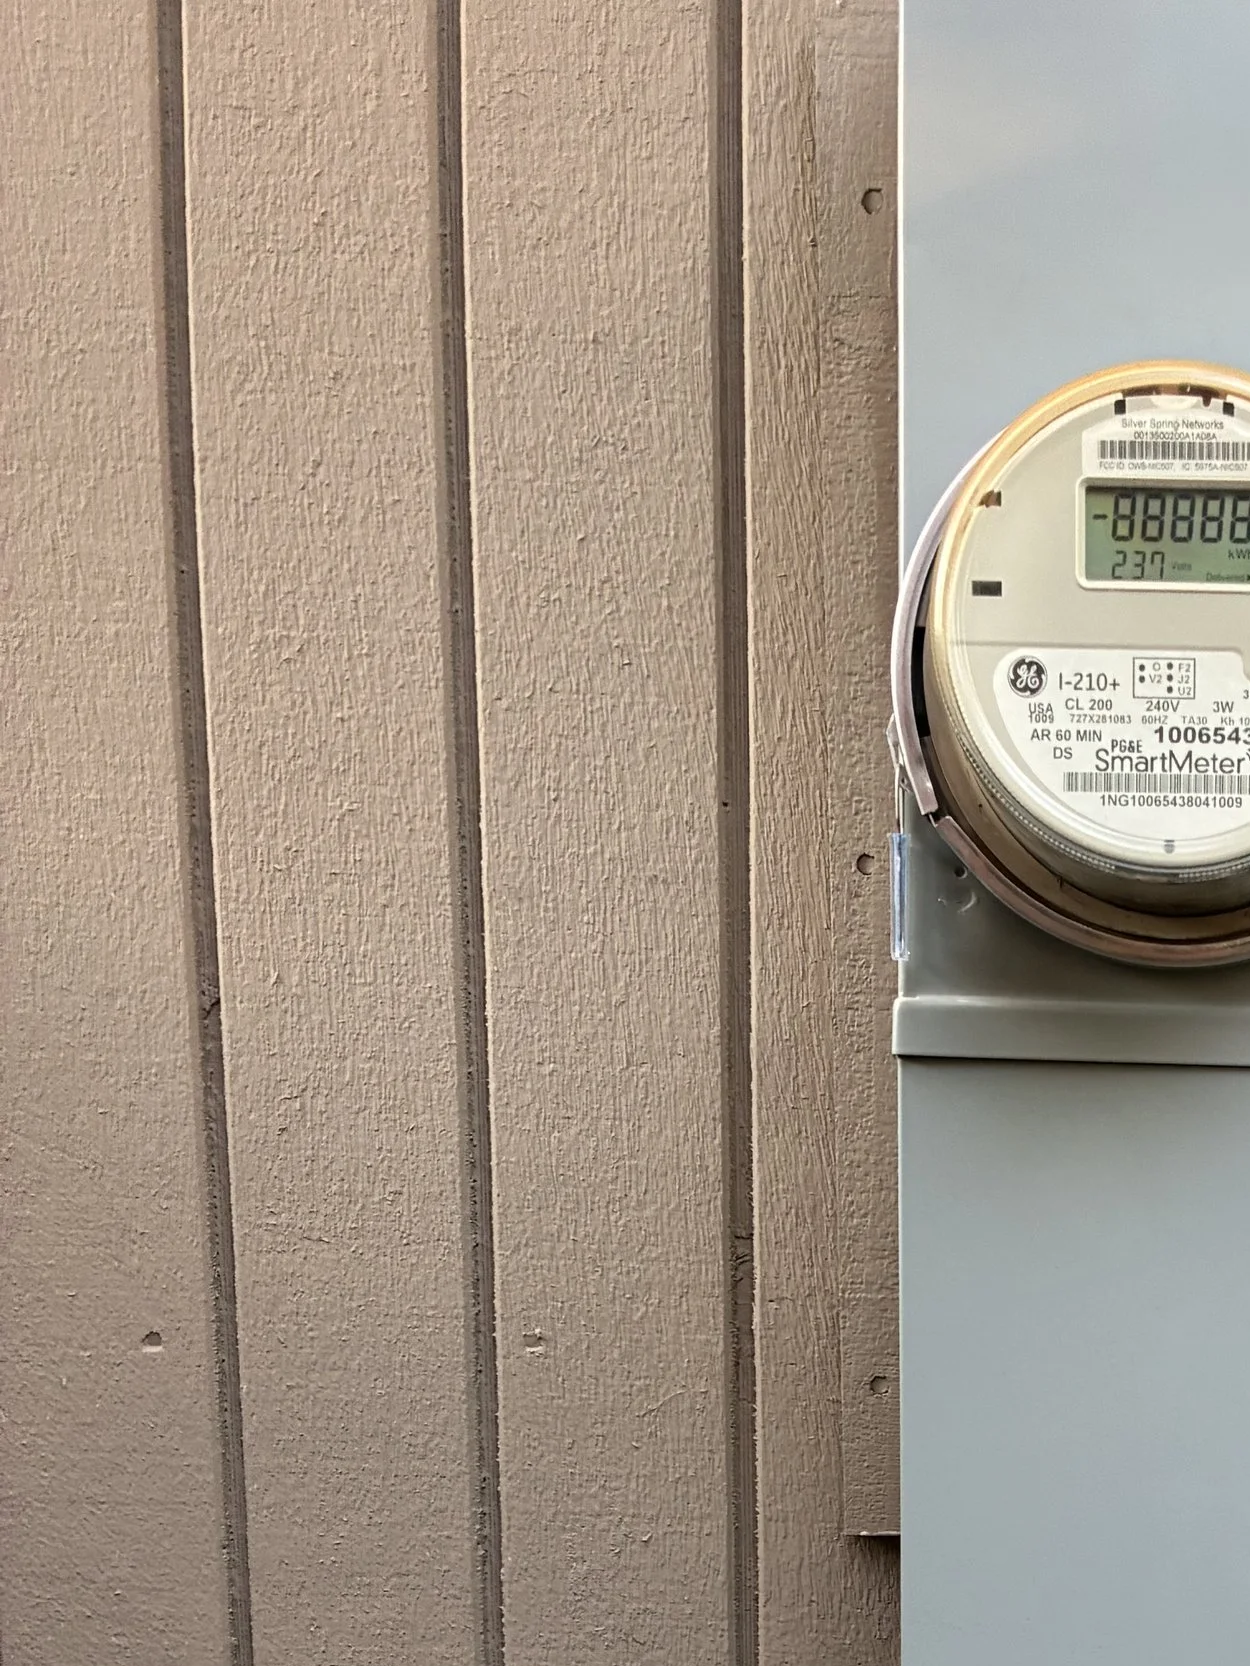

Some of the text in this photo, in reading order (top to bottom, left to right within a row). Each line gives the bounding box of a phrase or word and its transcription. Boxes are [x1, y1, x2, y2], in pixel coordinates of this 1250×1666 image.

[1121, 418, 1224, 432] Silver Spring Networks
[1111, 550, 1165, 580] 237
[1178, 662, 1191, 673] F2
[1149, 674, 1163, 684] V2
[1178, 674, 1191, 684] J2
[1028, 702, 1054, 714] USA
[1065, 698, 1084, 711] CL
[1088, 698, 1113, 711] 200
[1145, 700, 1180, 713] 240V
[1212, 701, 1235, 713] 3W
[1028, 714, 1054, 724] 1009
[1070, 714, 1132, 725] 727X281083
[1141, 715, 1168, 725] 60HZ
[1181, 715, 1208, 725] TA30
[1220, 715, 1235, 726] Kh
[1030, 729, 1102, 743] AR 60 MIN
[1111, 738, 1143, 754] PG&E
[1053, 747, 1073, 760] DS
[1095, 748, 1245, 774] SmartMeter
[1100, 794, 1243, 808] 1NG10065438041009
